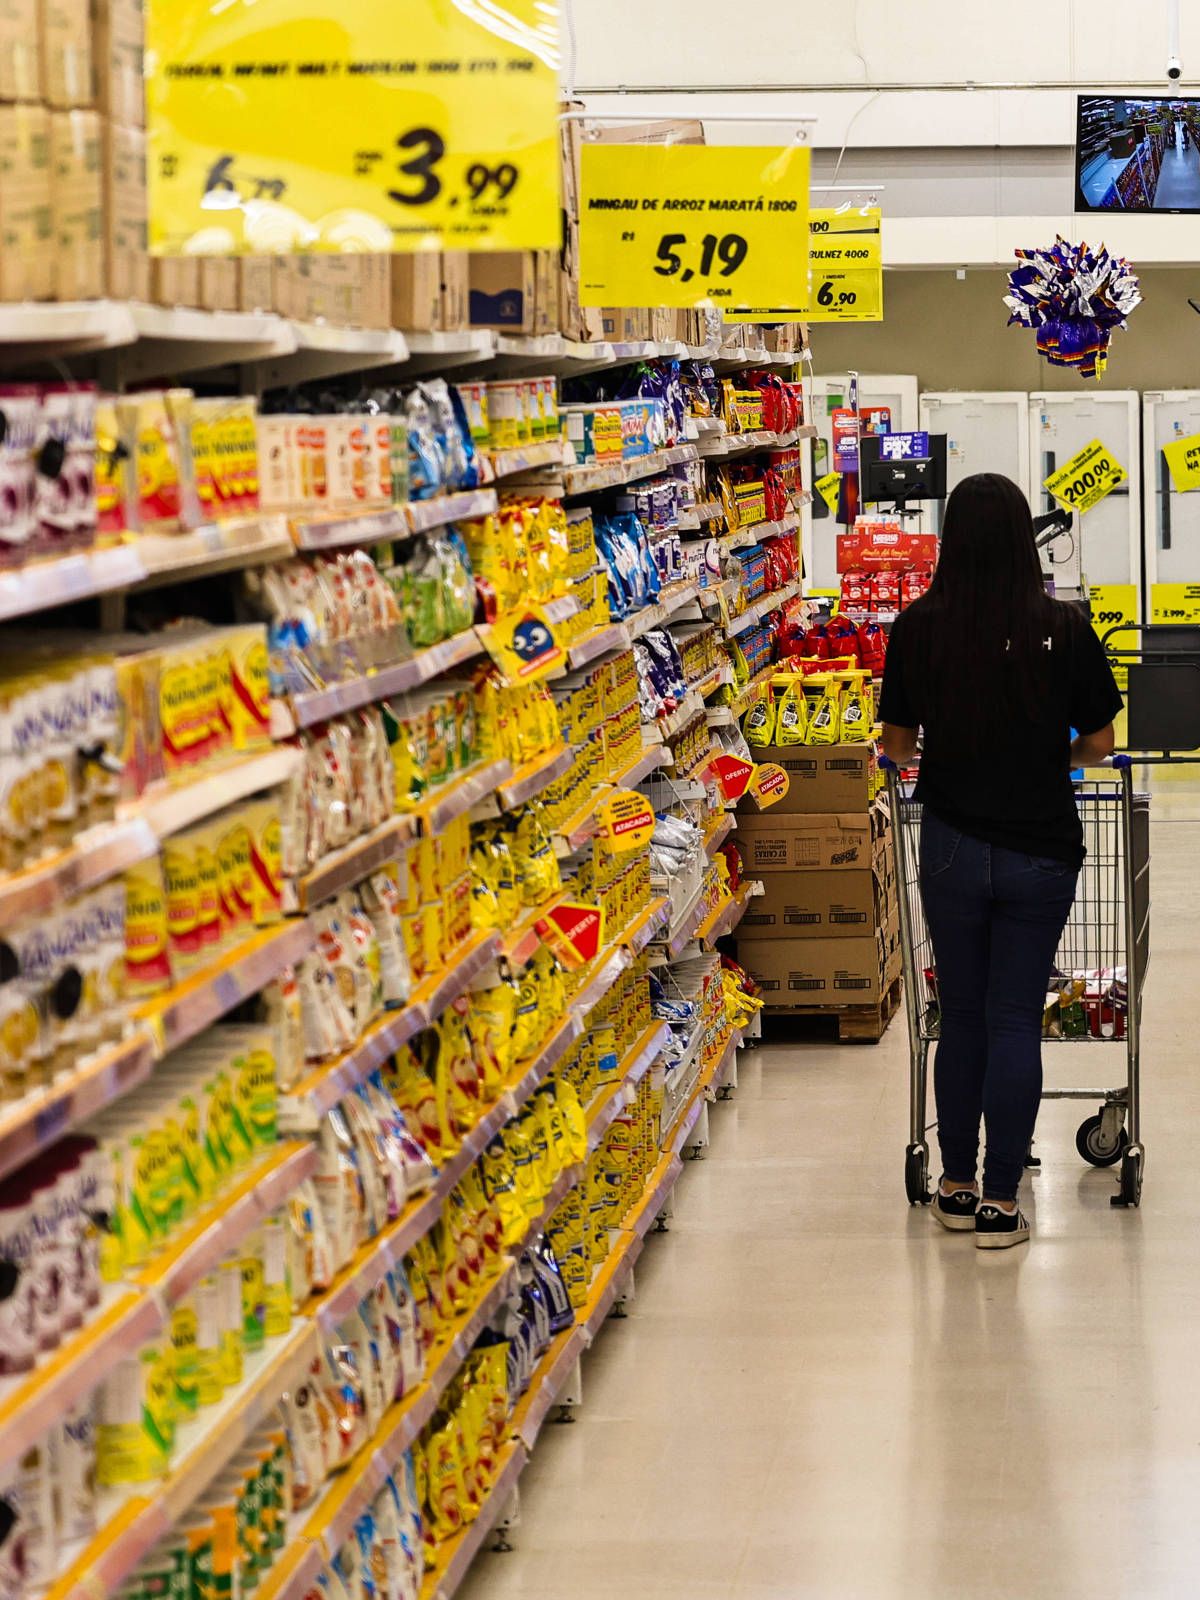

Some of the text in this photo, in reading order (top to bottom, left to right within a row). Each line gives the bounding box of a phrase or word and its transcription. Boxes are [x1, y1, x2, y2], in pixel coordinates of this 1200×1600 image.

[388, 127, 519, 208] 3,99
[588, 196, 798, 212] MINGAU DE ARROZ MARATÁ 180G
[653, 233, 749, 283] 5,19
[844, 250, 869, 259] 400G
[817, 281, 857, 307] 6,90
[1187, 461, 1200, 471] NA
[1064, 458, 1110, 503] 200,00
[724, 766, 751, 781] OFERTA
[760, 774, 784, 792] ATACADO
[615, 814, 651, 834] ATACADO
[565, 913, 599, 941] OFERTA
